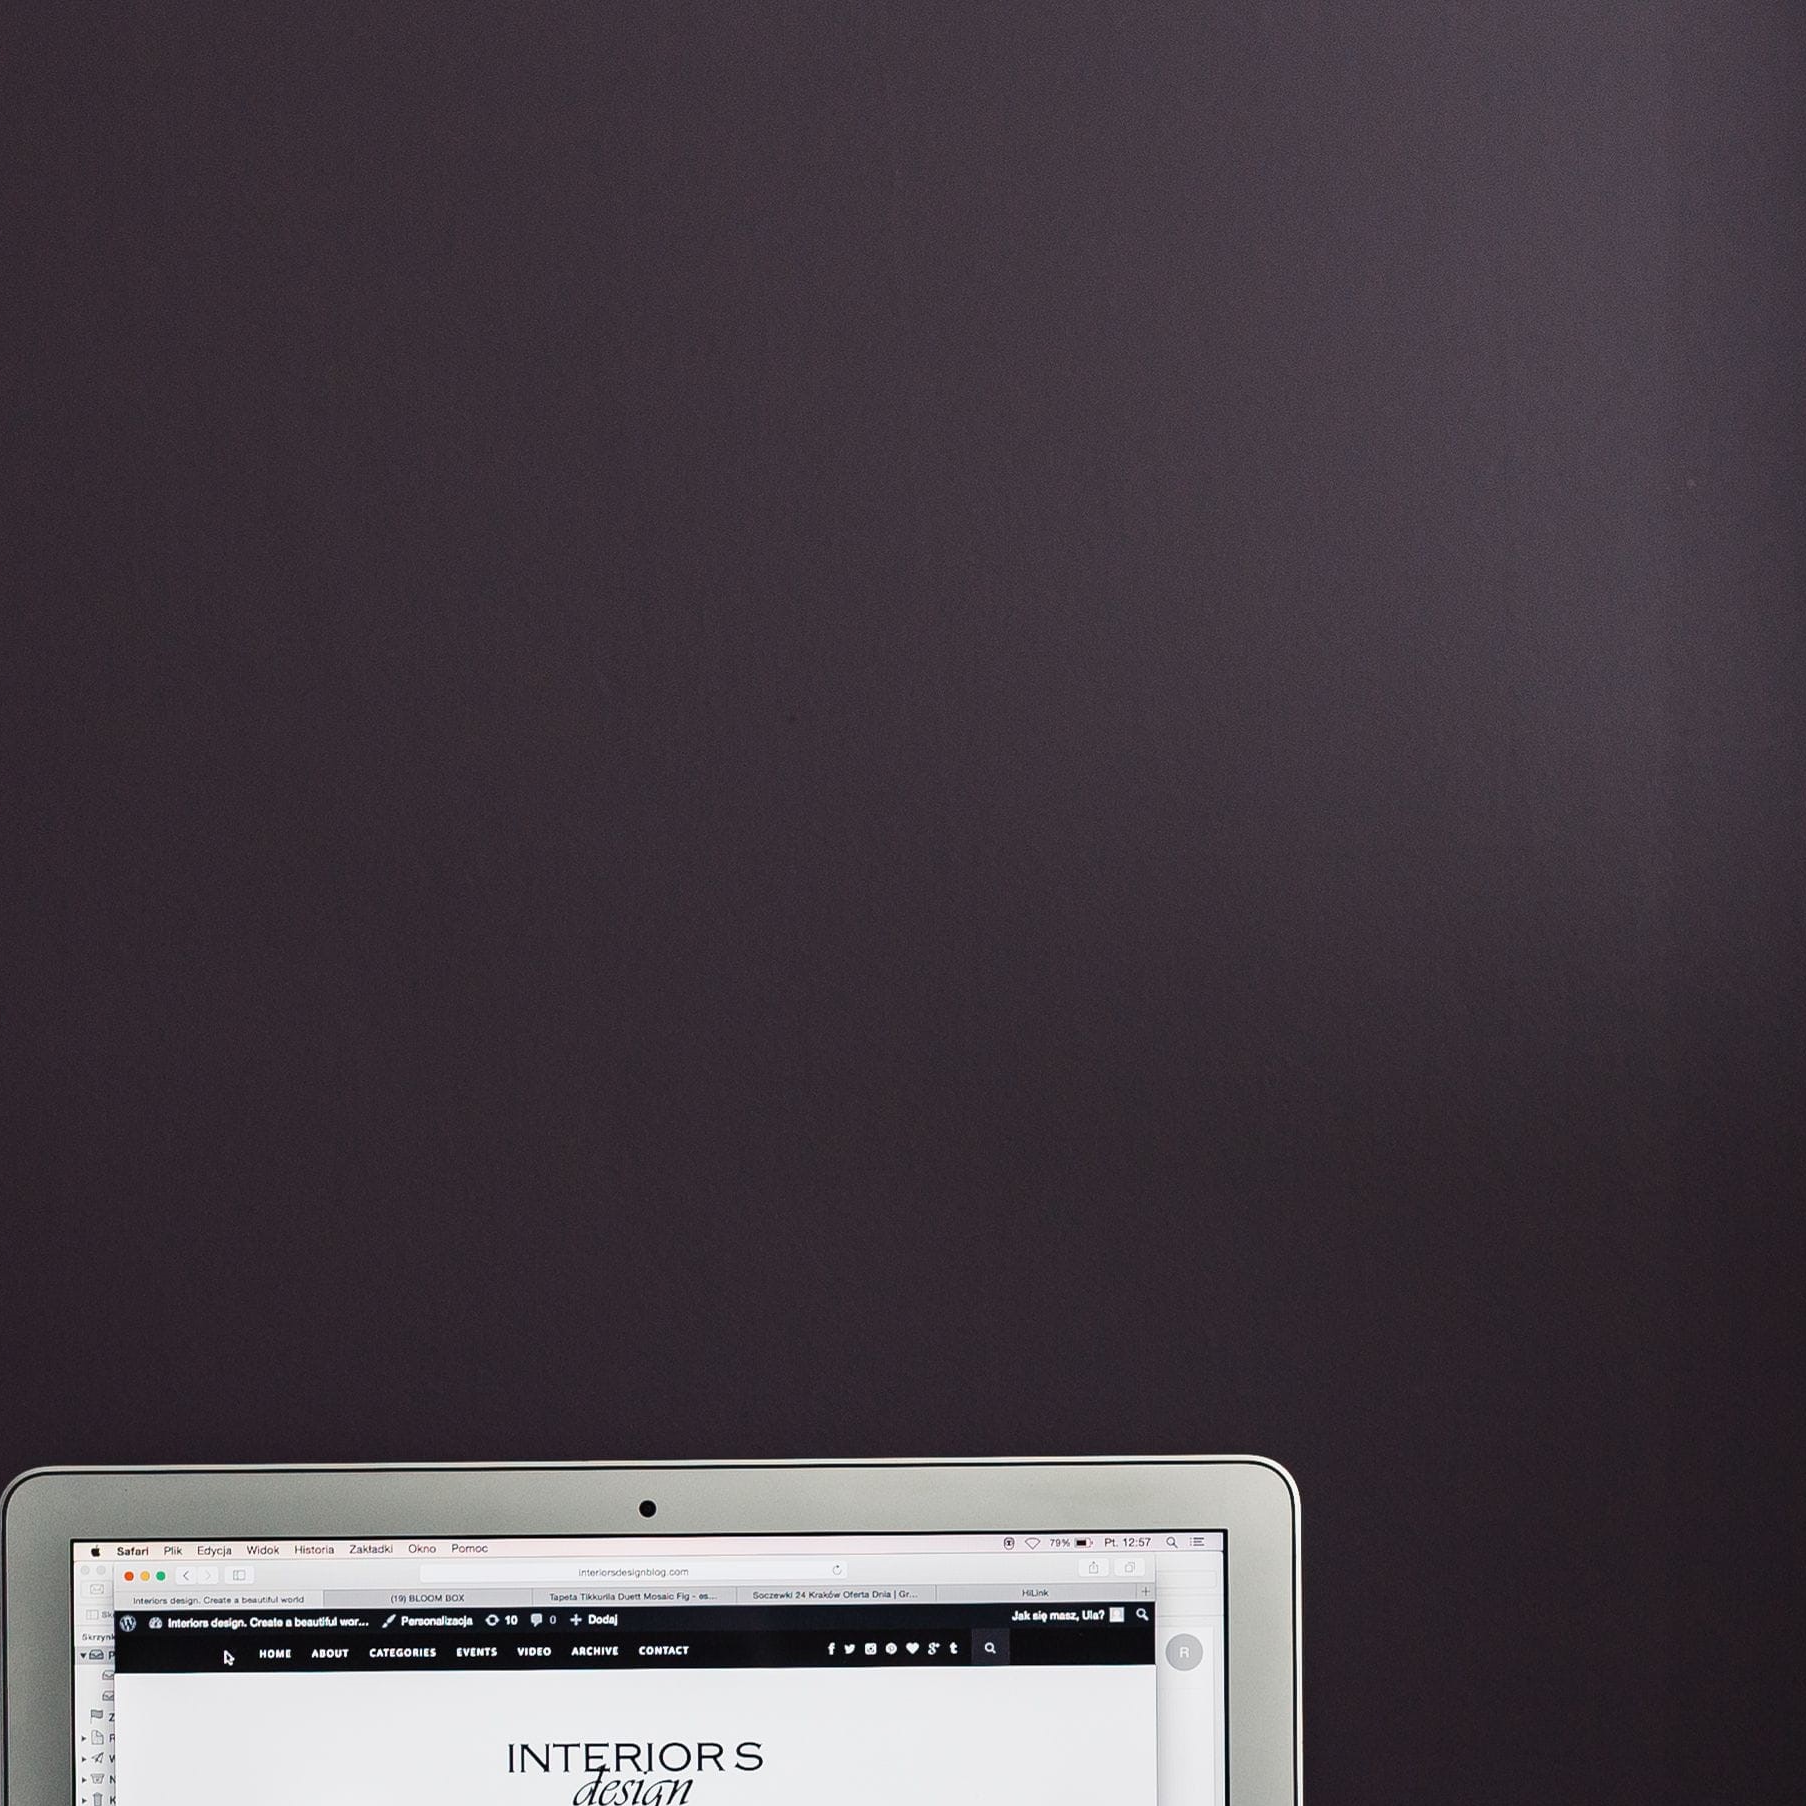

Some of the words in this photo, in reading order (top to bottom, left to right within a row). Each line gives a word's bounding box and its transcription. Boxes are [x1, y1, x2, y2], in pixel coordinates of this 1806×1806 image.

[1050, 1539, 1070, 1547] 79%
[1104, 1538, 1118, 1547] Pt.
[1123, 1538, 1151, 1547] 12:57
[117, 1547, 149, 1556] Safari
[164, 1546, 183, 1556] Plik
[197, 1545, 232, 1558] Edycja
[247, 1545, 279, 1555] Widok
[294, 1545, 335, 1555] Historia
[349, 1544, 394, 1554] Zakładki
[408, 1544, 437, 1554] Okno
[451, 1544, 489, 1553] Pomoc
[578, 1568, 689, 1577] interiorsdesignblog.com
[133, 1596, 167, 1605] Interiors
[169, 1596, 200, 1606] design.
[203, 1596, 232, 1604] Create
[242, 1596, 279, 1604] beautiful
[280, 1595, 305, 1603] world
[390, 1594, 407, 1604] (19)
[408, 1594, 443, 1602] BLOOM
[445, 1594, 465, 1602] BOX
[550, 1593, 578, 1601] Tapeta
[644, 1592, 674, 1600] Mosaic
[752, 1590, 793, 1600] Soczewki
[795, 1591, 806, 1599] 24
[808, 1590, 840, 1599] Kraków
[843, 1590, 870, 1599] Oferta
[872, 1590, 892, 1599] Dnia
[401, 1616, 473, 1627] Personalizacja
[505, 1616, 518, 1625] 10
[549, 1616, 556, 1624] 0
[588, 1614, 618, 1627] Dodaj
[1012, 1611, 1031, 1621] Jak
[1033, 1611, 1047, 1623] się
[1049, 1612, 1079, 1621] masz,
[1082, 1610, 1105, 1620] Ula?
[168, 1618, 209, 1629] Interiors
[210, 1617, 248, 1631] design.
[249, 1617, 283, 1629] Create
[294, 1617, 337, 1628] beautiful
[259, 1649, 291, 1658] HOME
[311, 1649, 349, 1658] ABOUT
[369, 1648, 437, 1658] CATEGORIES
[456, 1647, 498, 1657] EVENTS
[517, 1647, 552, 1657] VIDEO
[571, 1646, 619, 1656] ARCHIVE
[638, 1645, 689, 1655] CONTACT
[1180, 1647, 1190, 1659] R
[507, 1742, 764, 1773] INTERIORS
